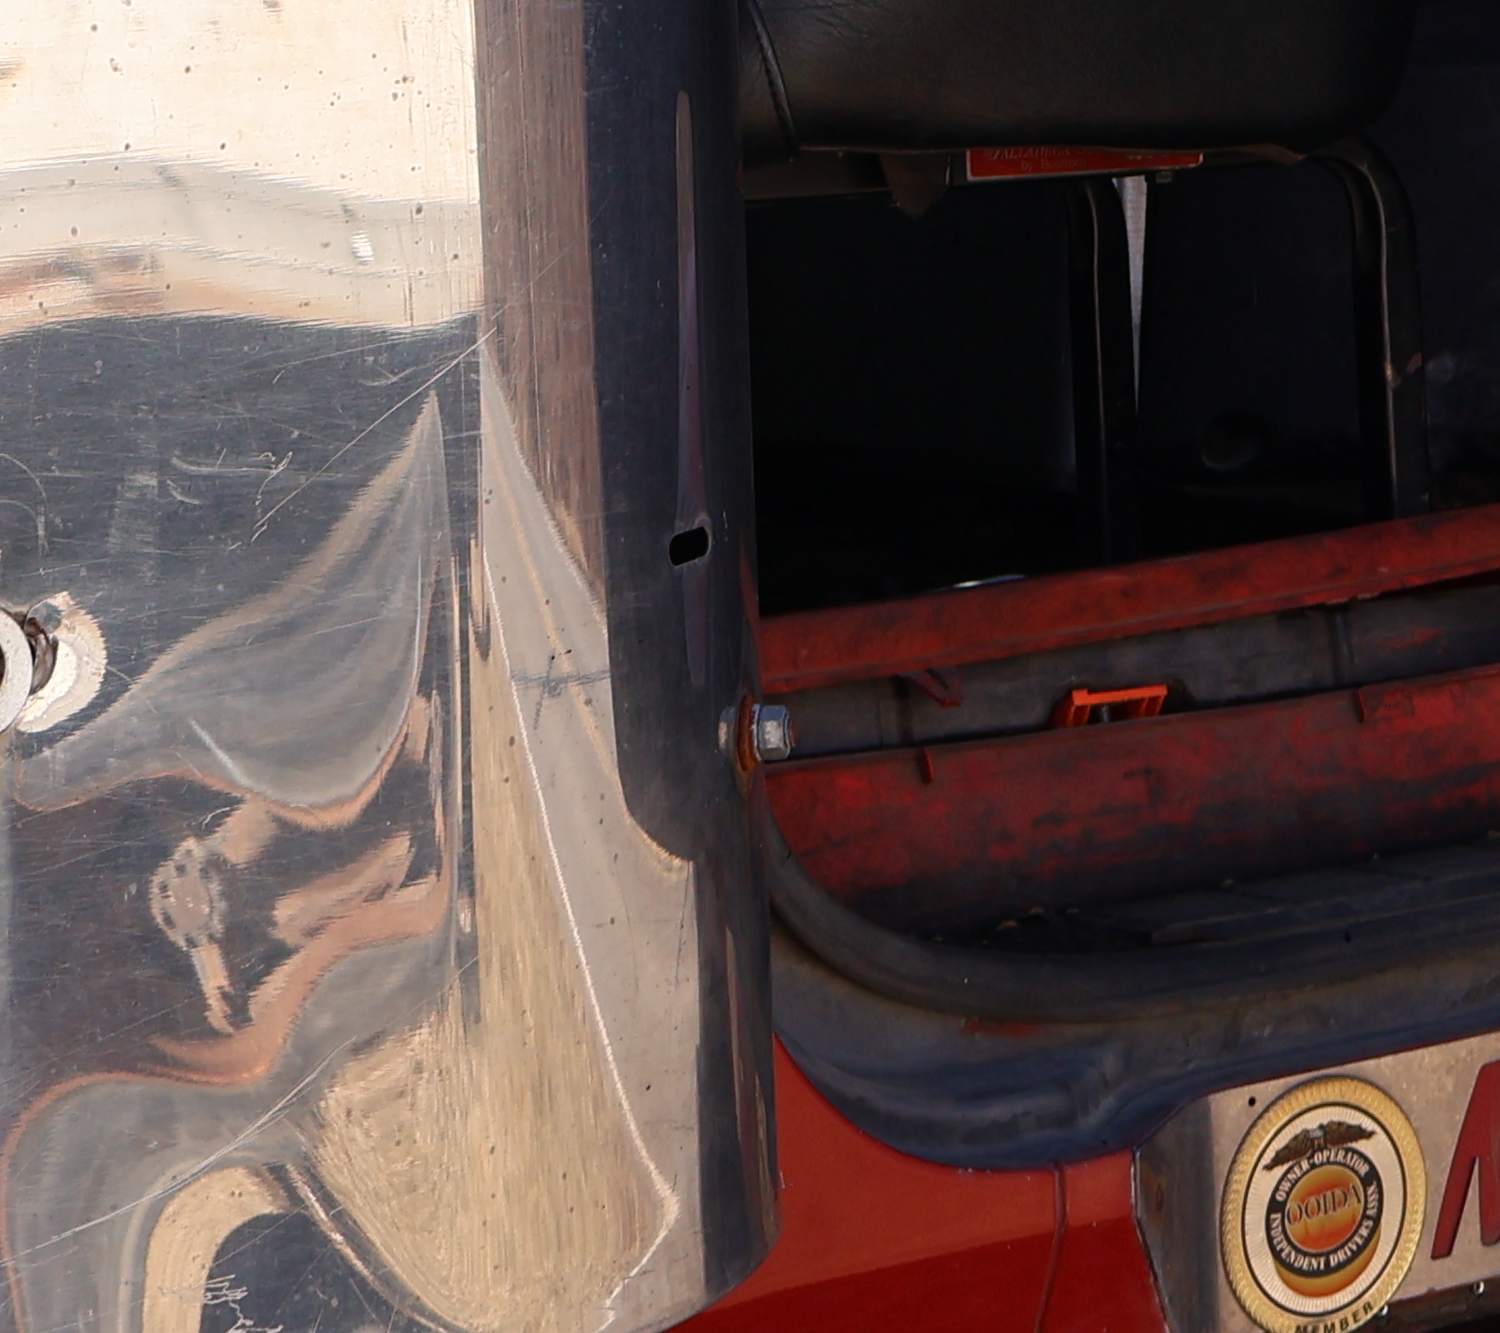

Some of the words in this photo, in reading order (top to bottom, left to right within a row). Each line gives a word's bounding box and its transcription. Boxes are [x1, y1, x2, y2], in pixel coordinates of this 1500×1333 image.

[1275, 1147, 1371, 1202] OWNER-OPERATOR
[1286, 1183, 1362, 1226] OOIDA
[1269, 1214, 1326, 1272] INDEPENDENT
[1330, 1221, 1375, 1269] DRIVERS
[1295, 1301, 1374, 1333] MEMBER
